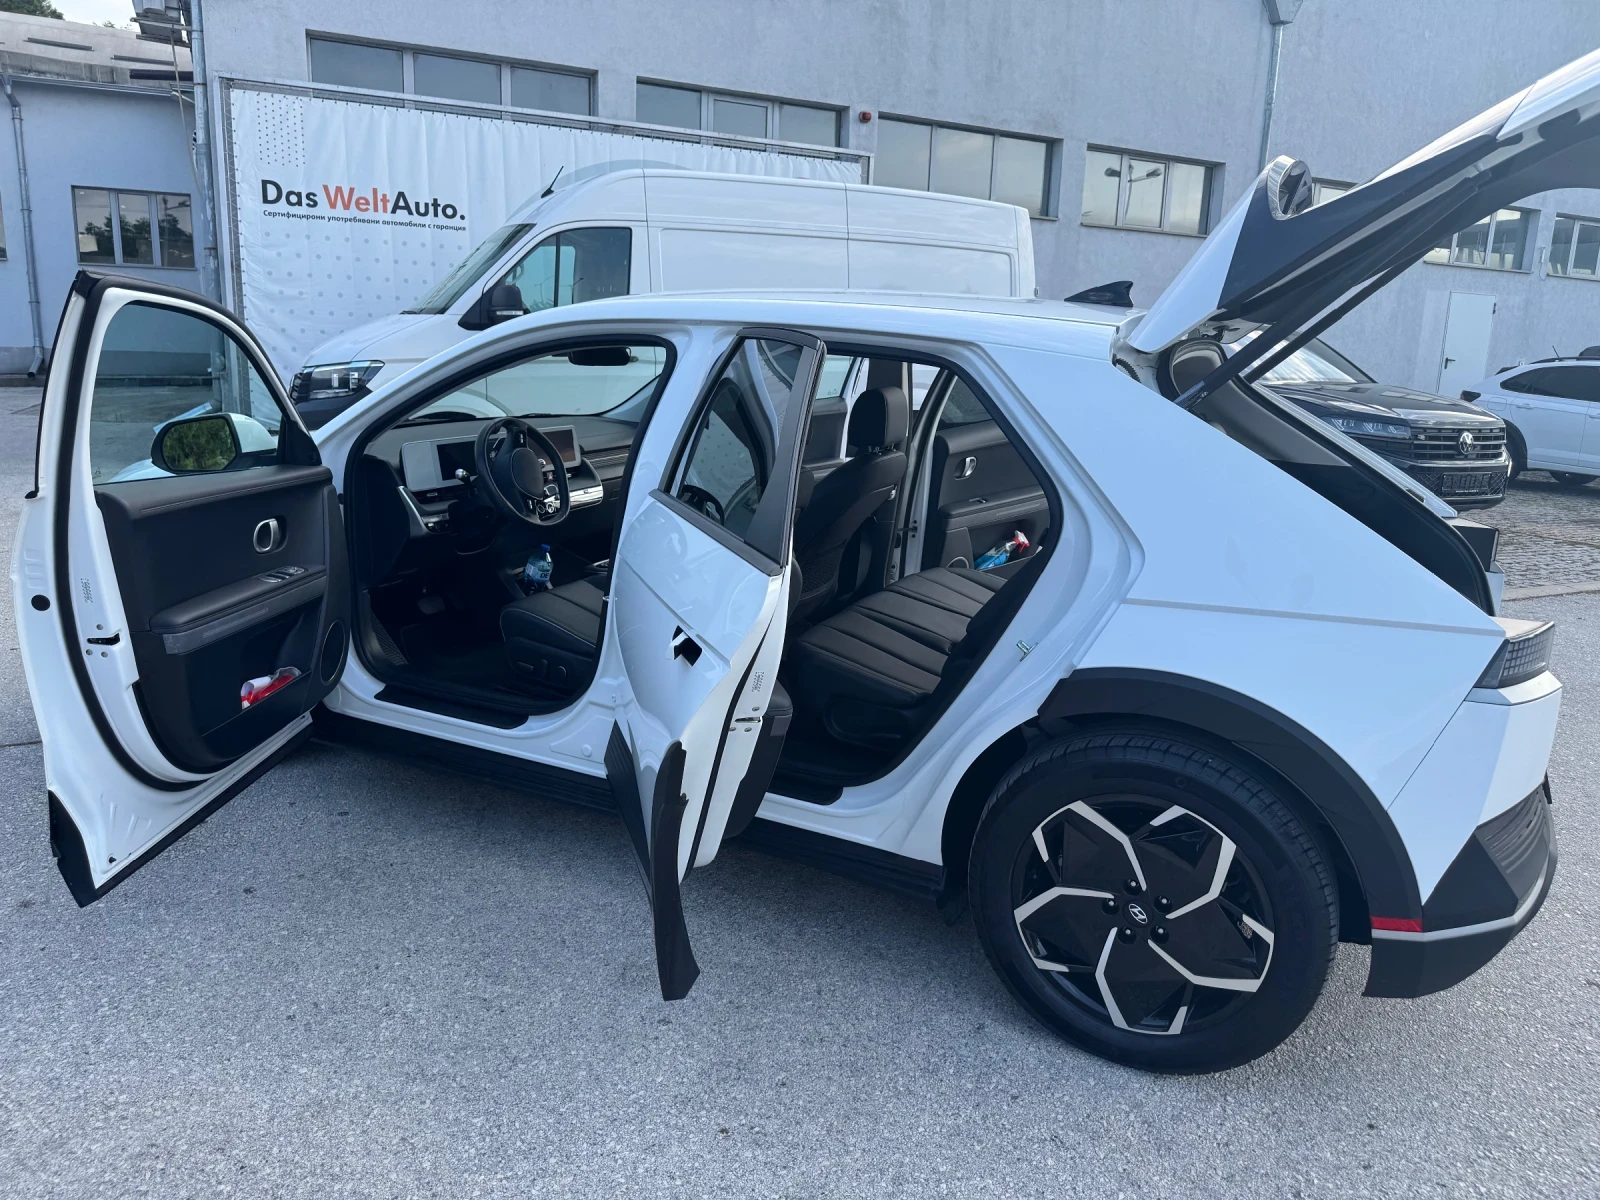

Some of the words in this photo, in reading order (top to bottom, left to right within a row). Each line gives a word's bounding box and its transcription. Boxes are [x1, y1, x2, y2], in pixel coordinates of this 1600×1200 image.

[261, 179, 319, 209] Das
[322, 184, 466, 221] WeltAuto.
[263, 209, 326, 222] Сертифицирани
[327, 216, 380, 226] употребявани
[382, 220, 427, 229] автомобили
